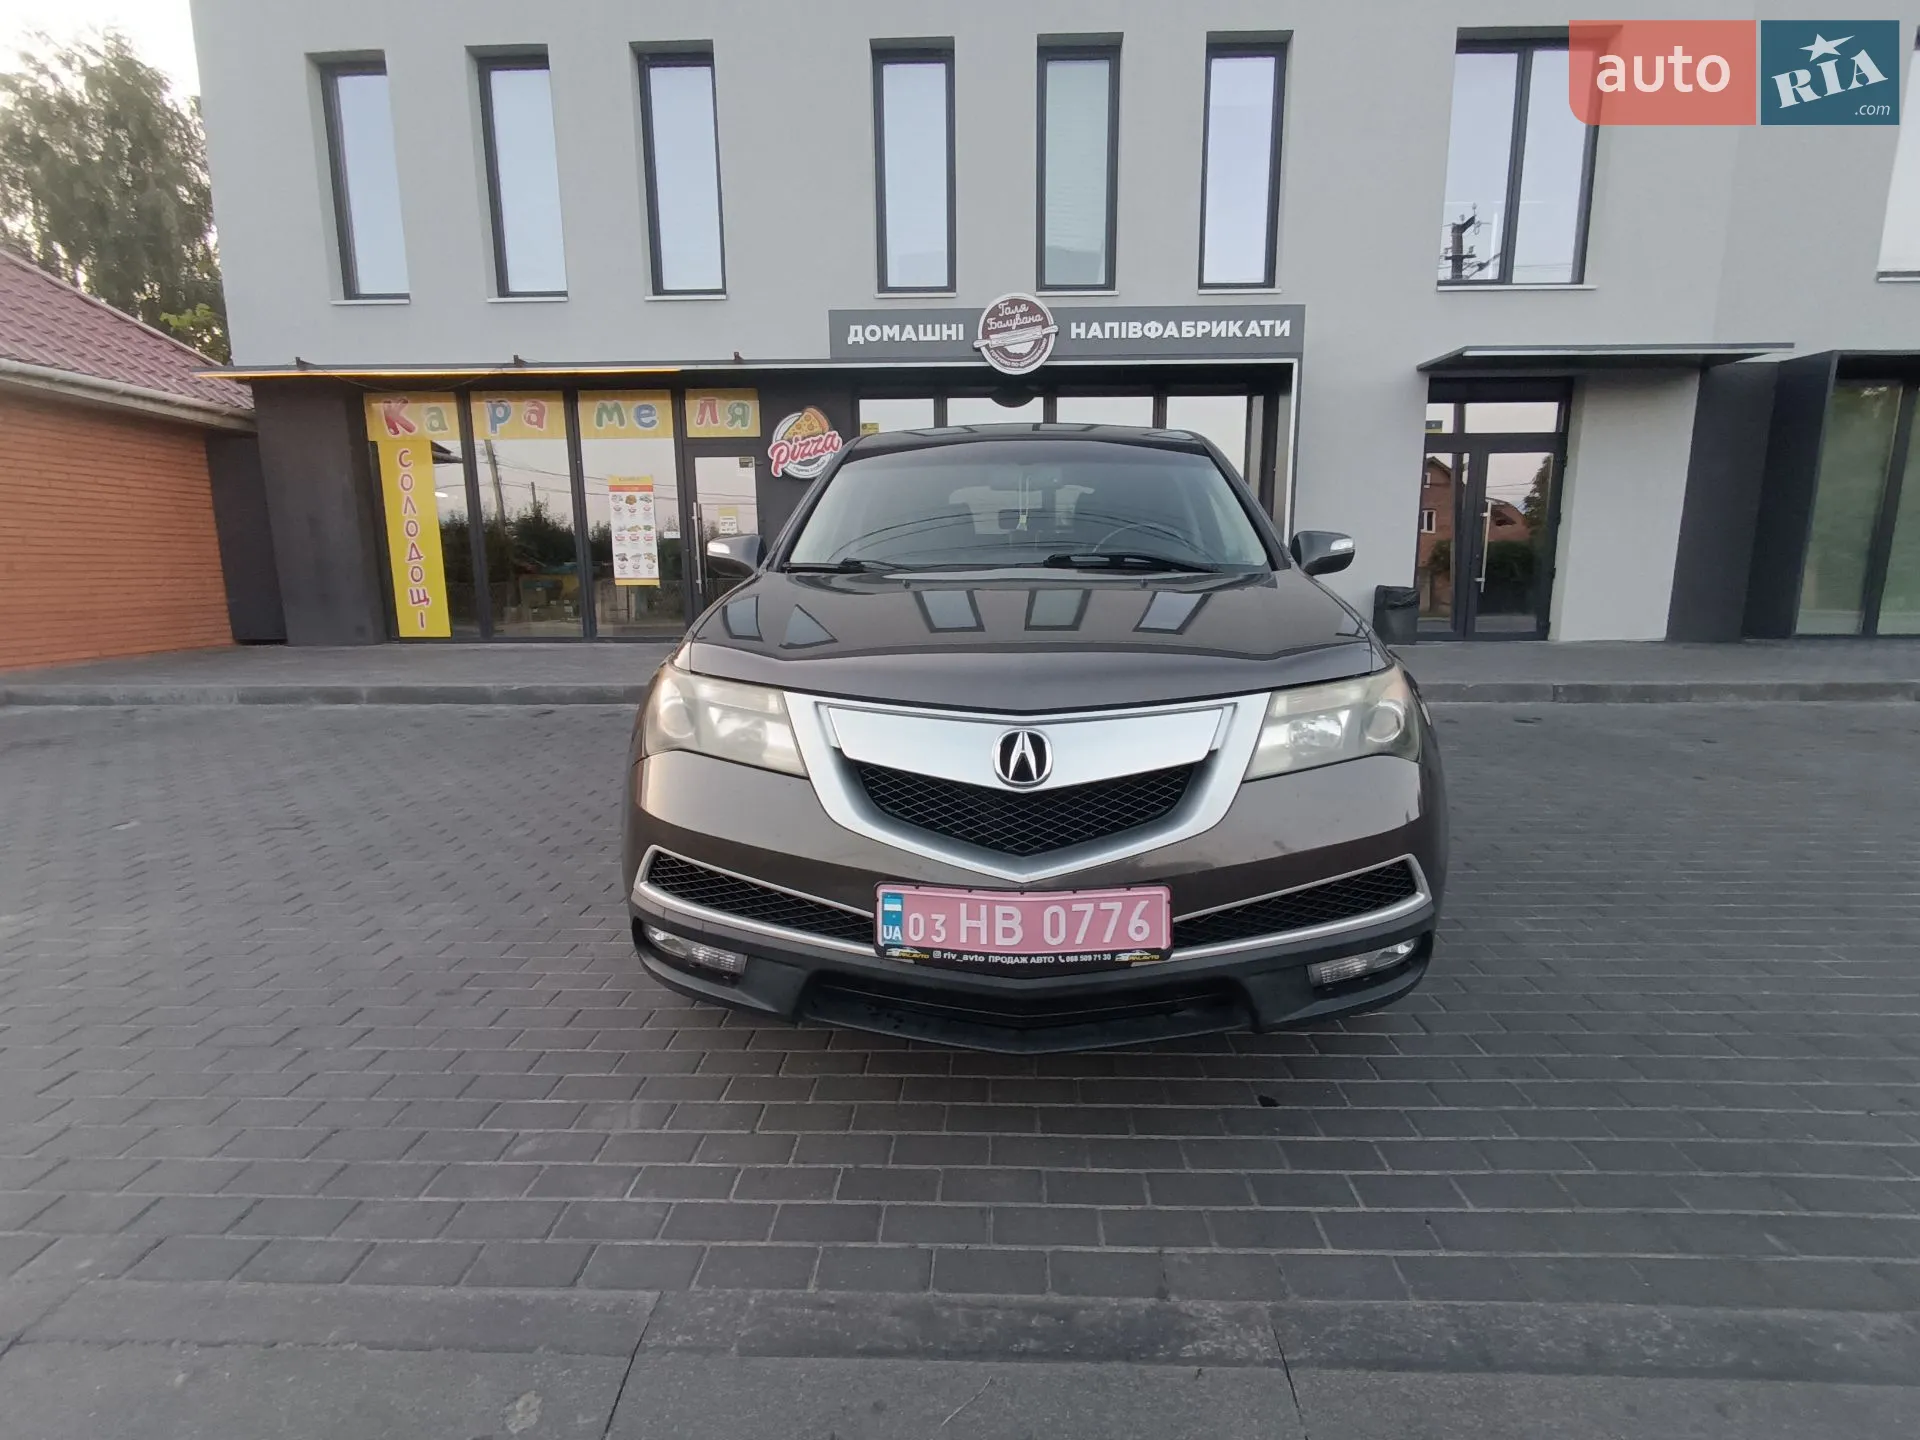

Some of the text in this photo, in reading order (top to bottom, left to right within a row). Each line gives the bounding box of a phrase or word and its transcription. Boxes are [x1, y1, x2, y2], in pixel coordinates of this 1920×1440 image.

[998, 301, 1029, 317] Галя
[986, 313, 1043, 330] Балувана
[847, 319, 1291, 345] ДОМАШНІ НАПІВФАБРИКАТИ
[768, 431, 842, 477] Pizza
[398, 448, 430, 630] СОЛОДОЩІ
[908, 912, 946, 943] 03
[1043, 900, 1151, 947] 0776
[883, 925, 902, 941] UA
[943, 951, 985, 962] riv_avto
[988, 955, 1055, 964] ПРОДАЖ АВТО
